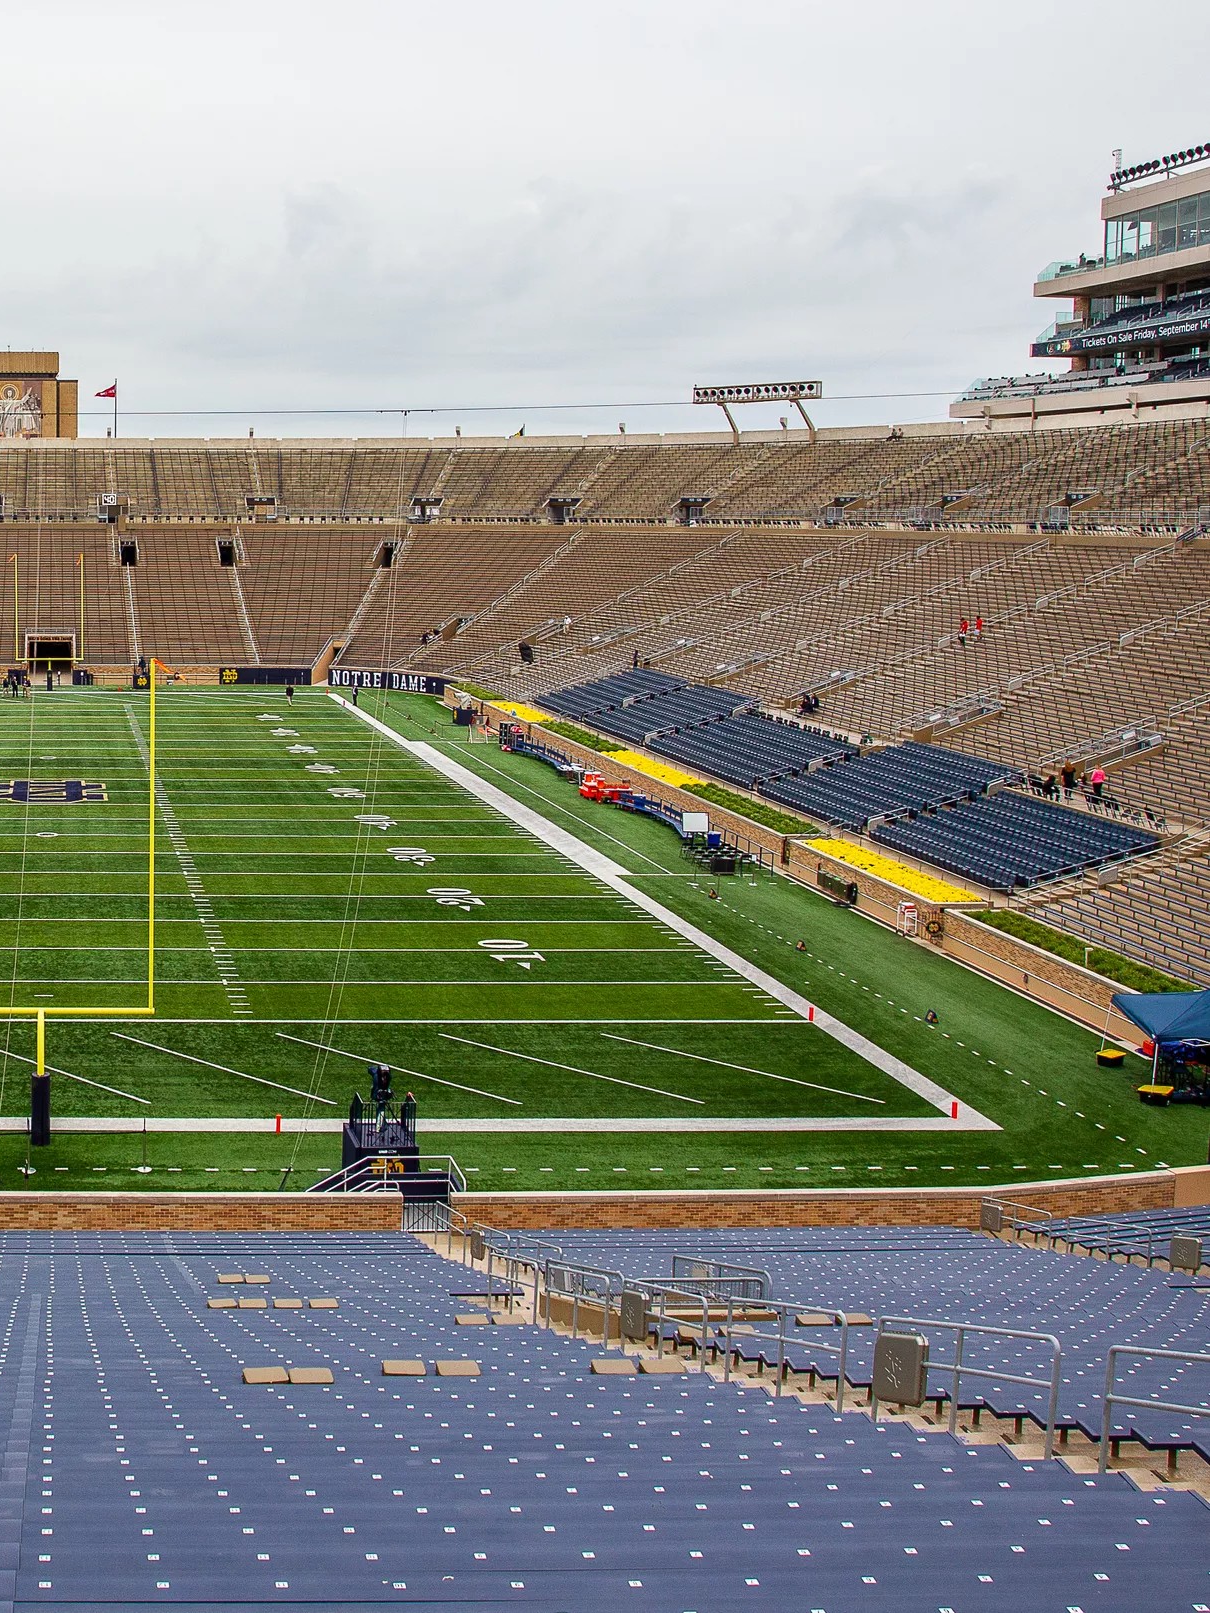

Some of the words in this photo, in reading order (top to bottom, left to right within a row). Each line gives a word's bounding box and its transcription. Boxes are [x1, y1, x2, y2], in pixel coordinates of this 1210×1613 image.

[1082, 337, 1106, 348] Tickets
[1107, 335, 1117, 344] On
[1118, 331, 1133, 342] Sale
[1133, 329, 1157, 341] Friday,
[1158, 321, 1198, 337] September
[331, 669, 382, 688] NOTRE
[392, 673, 427, 692] DAME
[386, 847, 436, 862] 30
[426, 887, 486, 906] 20
[477, 939, 546, 963] 10
